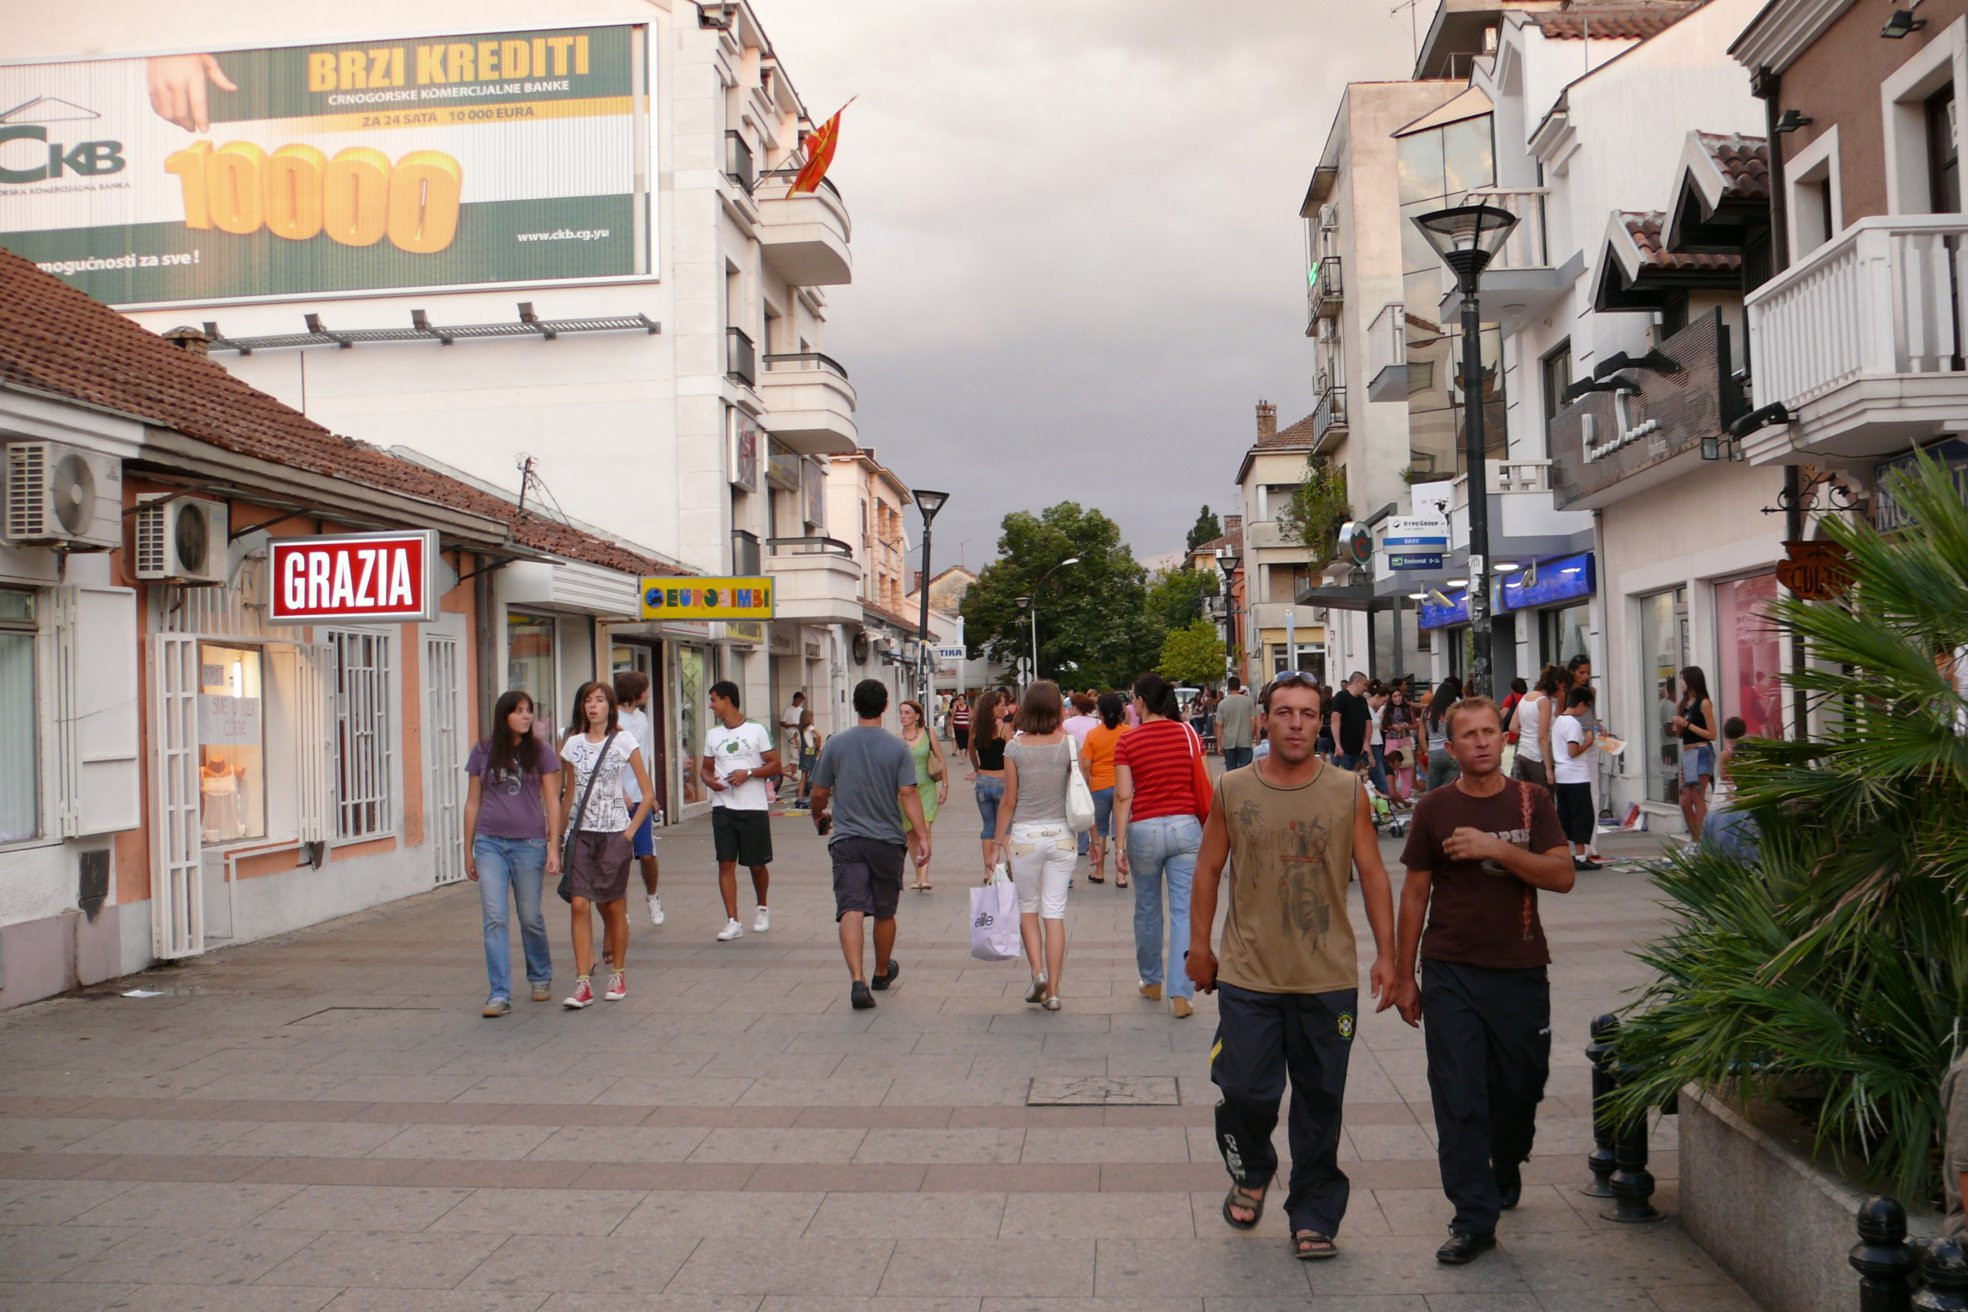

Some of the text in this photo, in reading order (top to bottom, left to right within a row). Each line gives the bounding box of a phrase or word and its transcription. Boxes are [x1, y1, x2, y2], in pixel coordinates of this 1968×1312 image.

[308, 35, 589, 92] BRZI KREDITI
[328, 79, 570, 106] CRNOGORSKE KOMERCIJALNE BANKE
[362, 106, 535, 128] ZA 24 SATA 10 000 EURA
[0, 124, 126, 184] CKB
[29, 182, 97, 195] KOMERCIJALNA
[99, 182, 131, 191] BANKA
[164, 139, 463, 254] 10000
[517, 229, 610, 242] www.ckb.cg.yu
[139, 255, 159, 268] za
[284, 548, 413, 610] GRAZIA
[666, 587, 770, 609] EUROBIMBI
